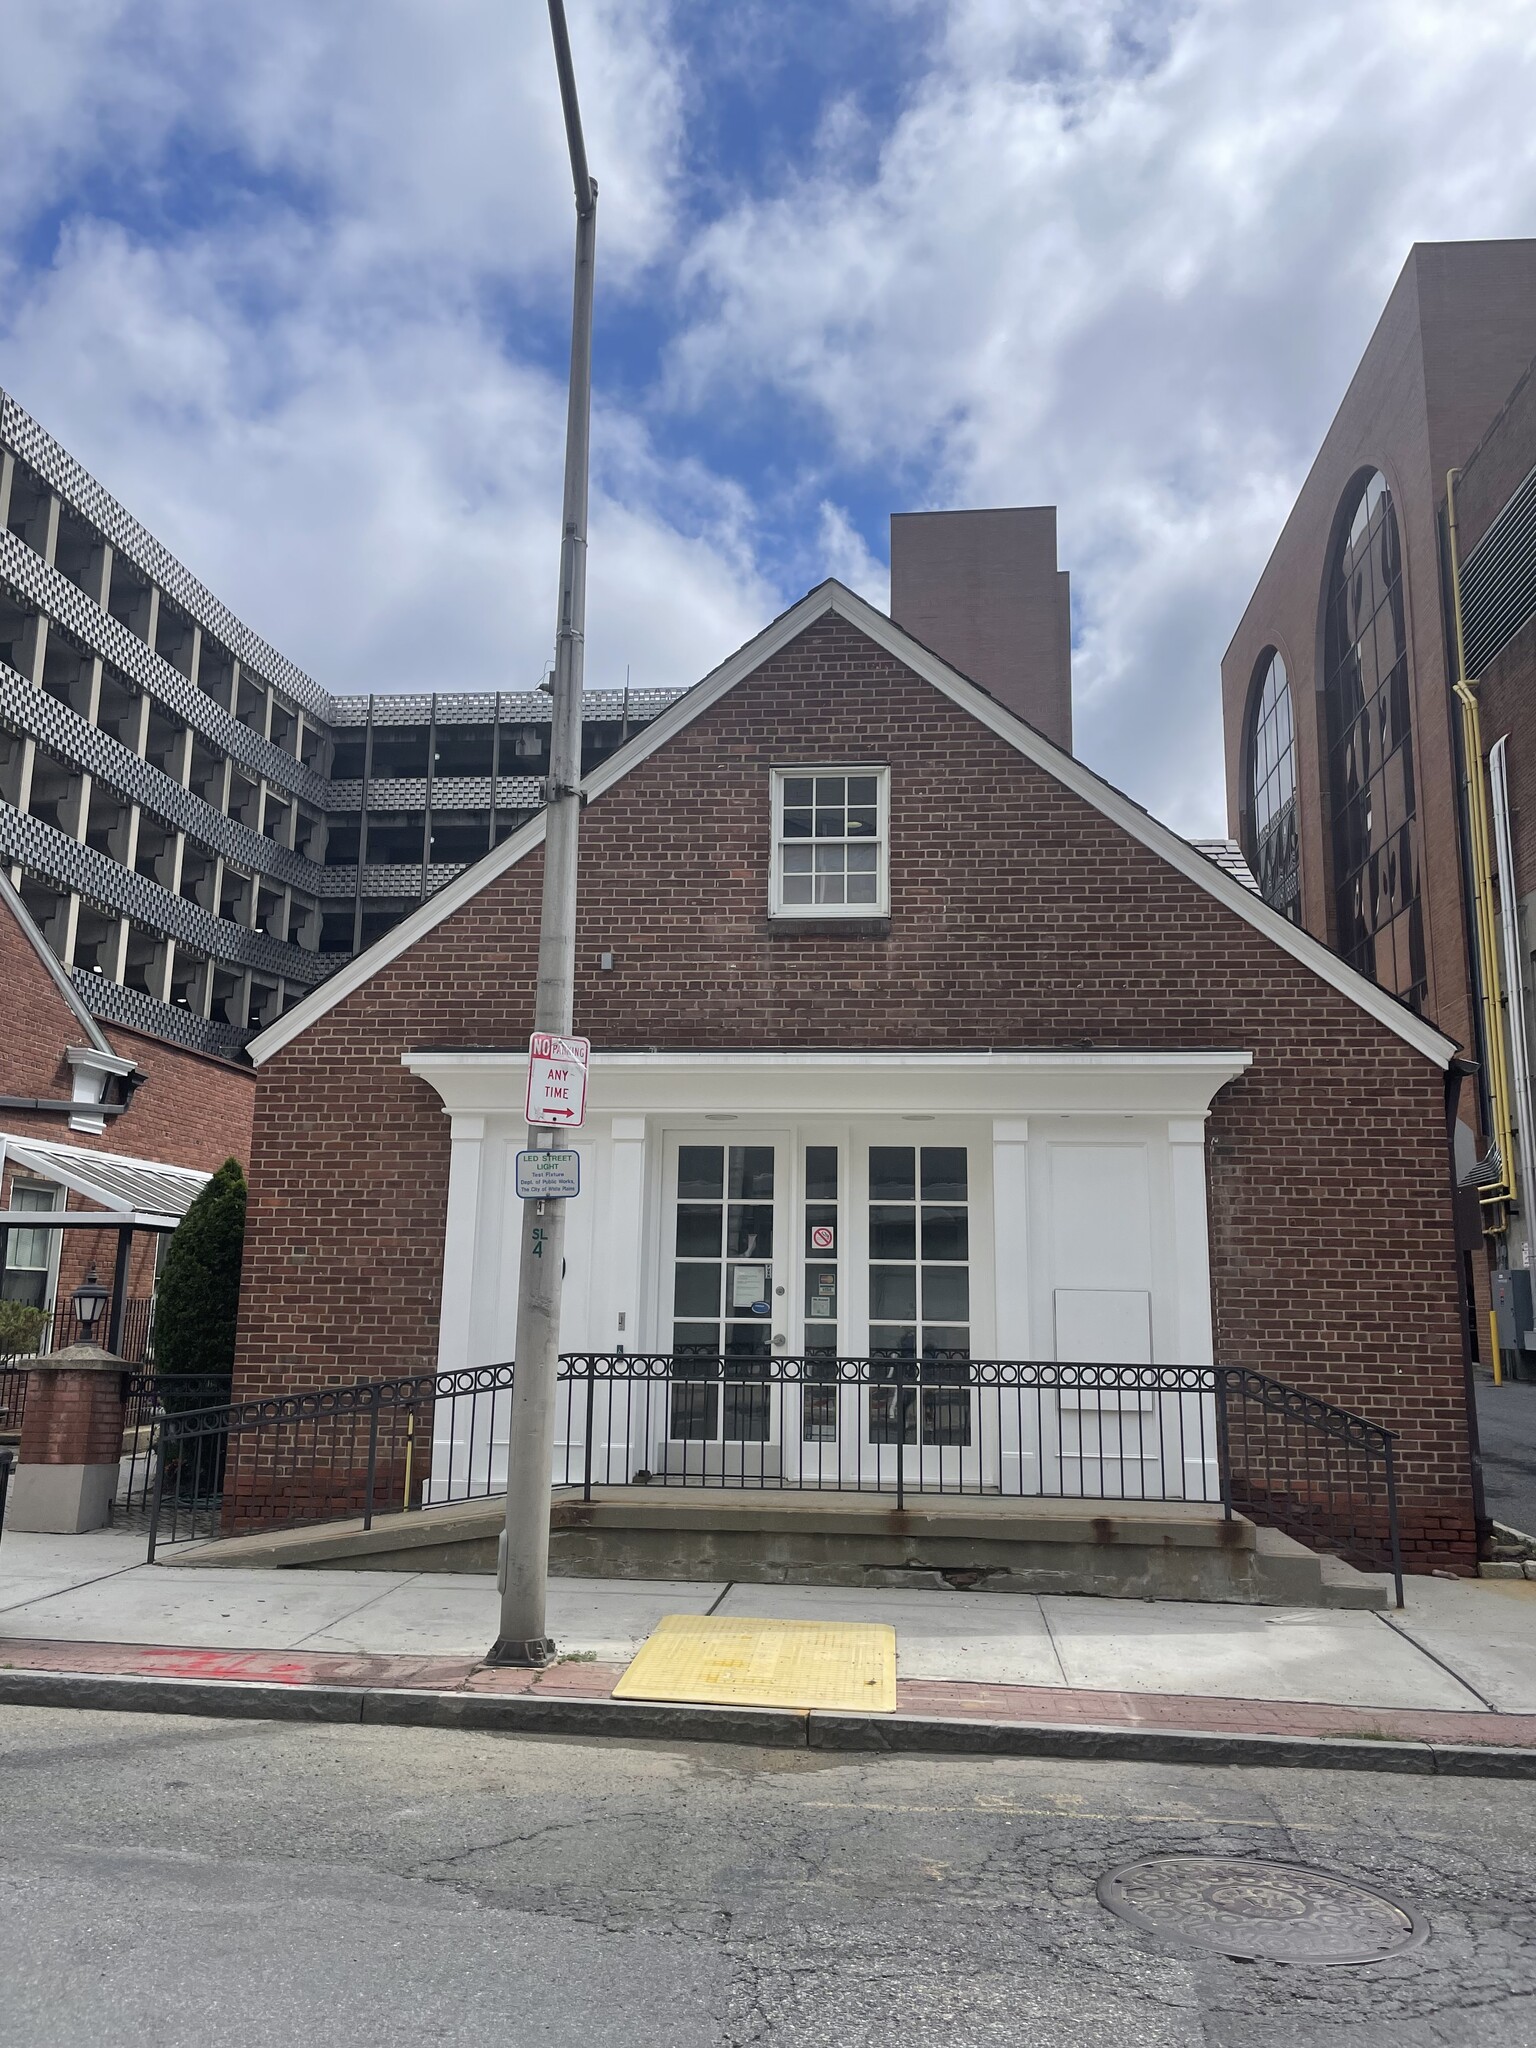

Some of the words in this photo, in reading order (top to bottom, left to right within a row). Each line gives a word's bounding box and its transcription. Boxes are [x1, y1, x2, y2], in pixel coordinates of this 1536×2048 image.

[533, 1038, 550, 1056] NO
[547, 1069, 569, 1081] ANY
[544, 1086, 569, 1099] TIME
[532, 1228, 548, 1240] SL
[532, 1241, 543, 1258] 4
